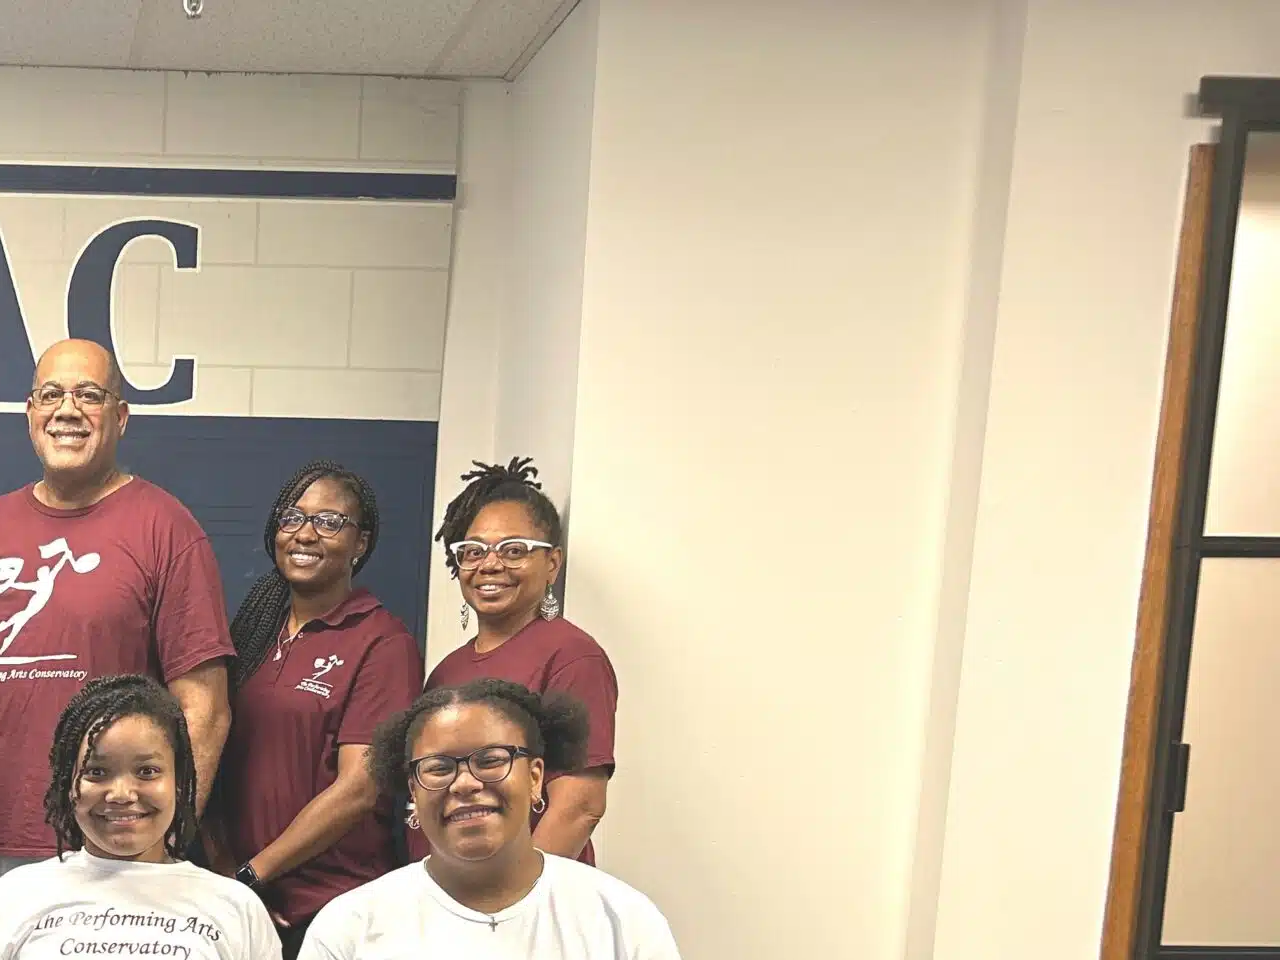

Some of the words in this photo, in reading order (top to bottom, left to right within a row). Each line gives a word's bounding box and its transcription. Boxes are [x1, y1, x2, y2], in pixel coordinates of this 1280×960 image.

[7, 669, 28, 680] Arts
[28, 668, 88, 681] Conservatory
[69, 907, 178, 933] Performing
[179, 915, 222, 942] Arts
